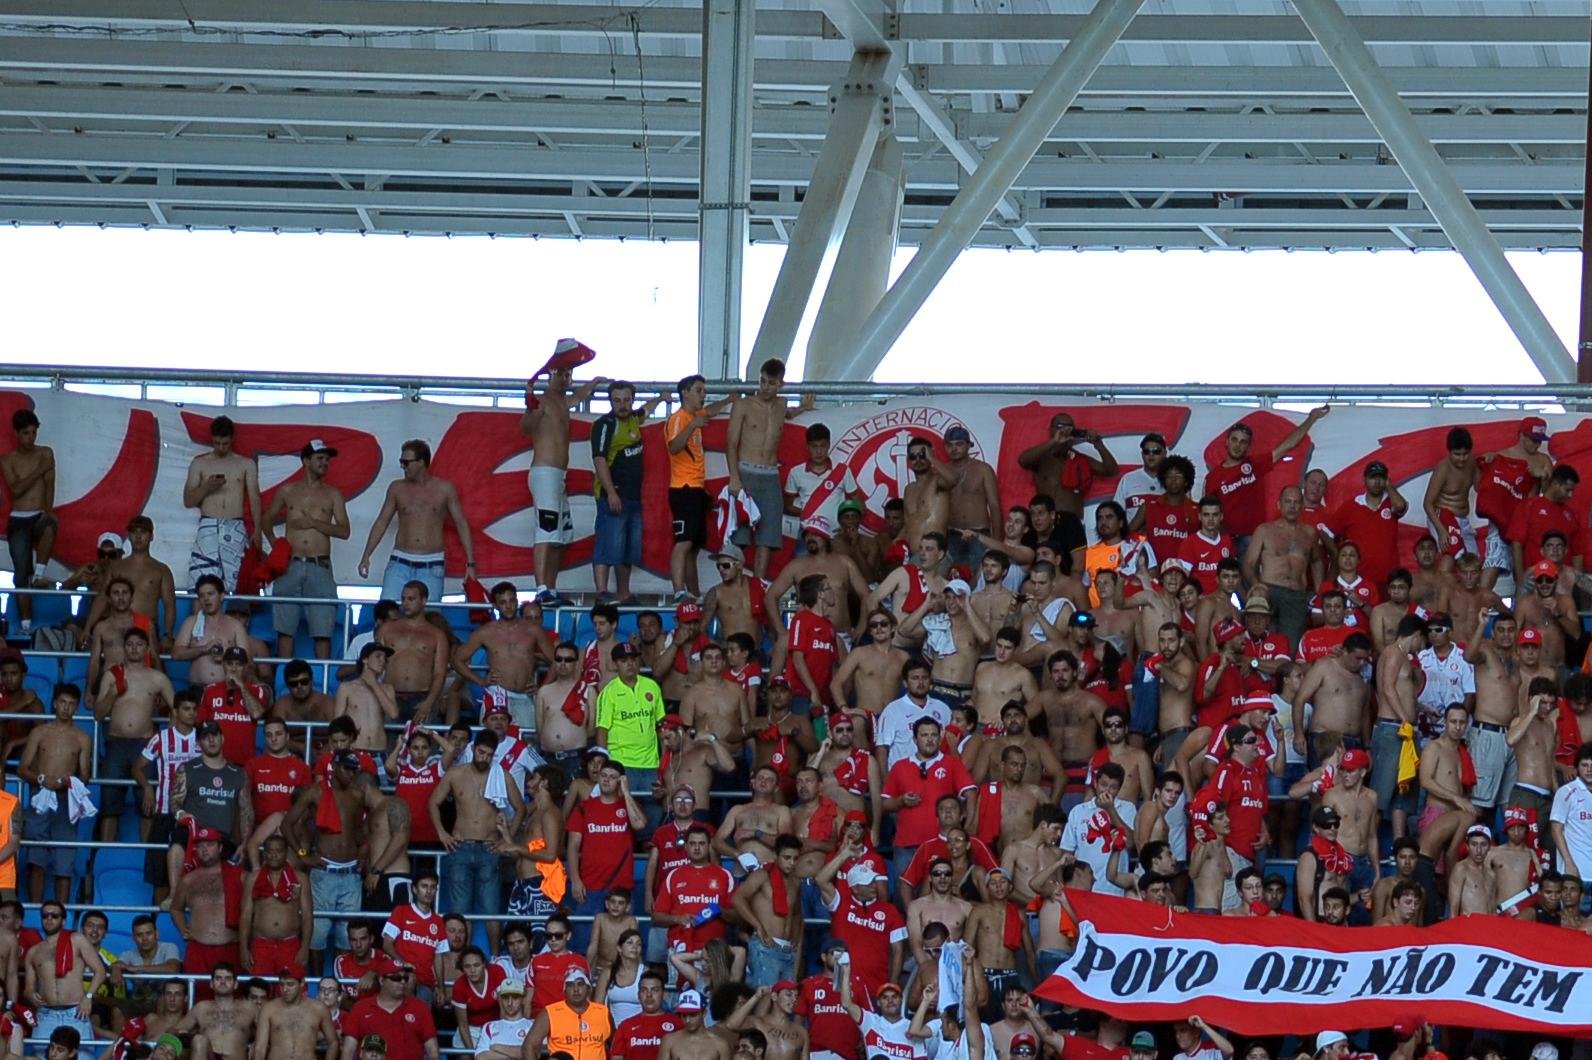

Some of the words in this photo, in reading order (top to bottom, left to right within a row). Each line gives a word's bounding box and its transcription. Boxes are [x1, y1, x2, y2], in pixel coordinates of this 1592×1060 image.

[1220, 475, 1257, 495] Banrisul
[212, 697, 223, 710] 10
[399, 775, 434, 785] Banrisul
[199, 786, 234, 798] Banrisul
[588, 821, 627, 833] Banrisul
[1073, 935, 1219, 997] POVO
[1243, 951, 1350, 996] QUE
[1351, 945, 1457, 998] NÃO
[1467, 954, 1581, 1013] TEM
[814, 990, 826, 999] 10
[630, 1037, 662, 1047] Banris
